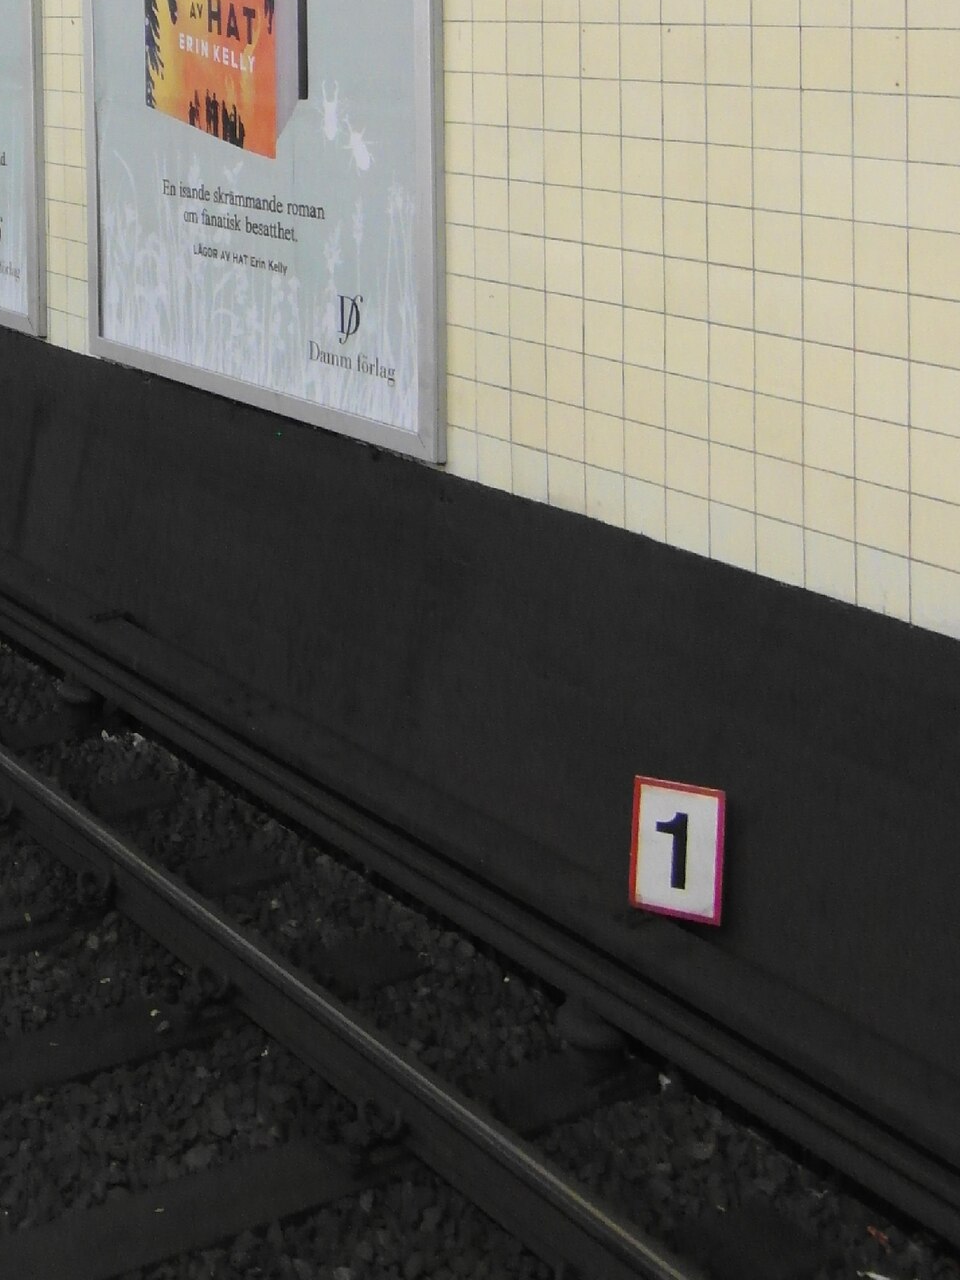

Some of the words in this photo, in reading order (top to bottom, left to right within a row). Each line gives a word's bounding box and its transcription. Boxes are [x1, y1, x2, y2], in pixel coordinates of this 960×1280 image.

[190, 2, 203, 20] AV
[178, 32, 209, 59] ERIN
[212, 43, 256, 73] KELLY
[162, 179, 177, 196] En
[179, 182, 211, 202] isande
[213, 186, 284, 213] skrämmande
[287, 202, 326, 220] roman
[183, 209, 199, 224] om
[201, 208, 241, 231] fanatisk
[245, 216, 298, 242] besatthet.
[193, 243, 218, 259] LÅGOR
[220, 251, 231, 261] AV
[233, 253, 249, 265] HAT
[250, 256, 266, 270] Erin
[268, 260, 288, 276] Kelly
[309, 340, 352, 370] Damm
[357, 351, 396, 388] förlag
[655, 811, 688, 889] 1
